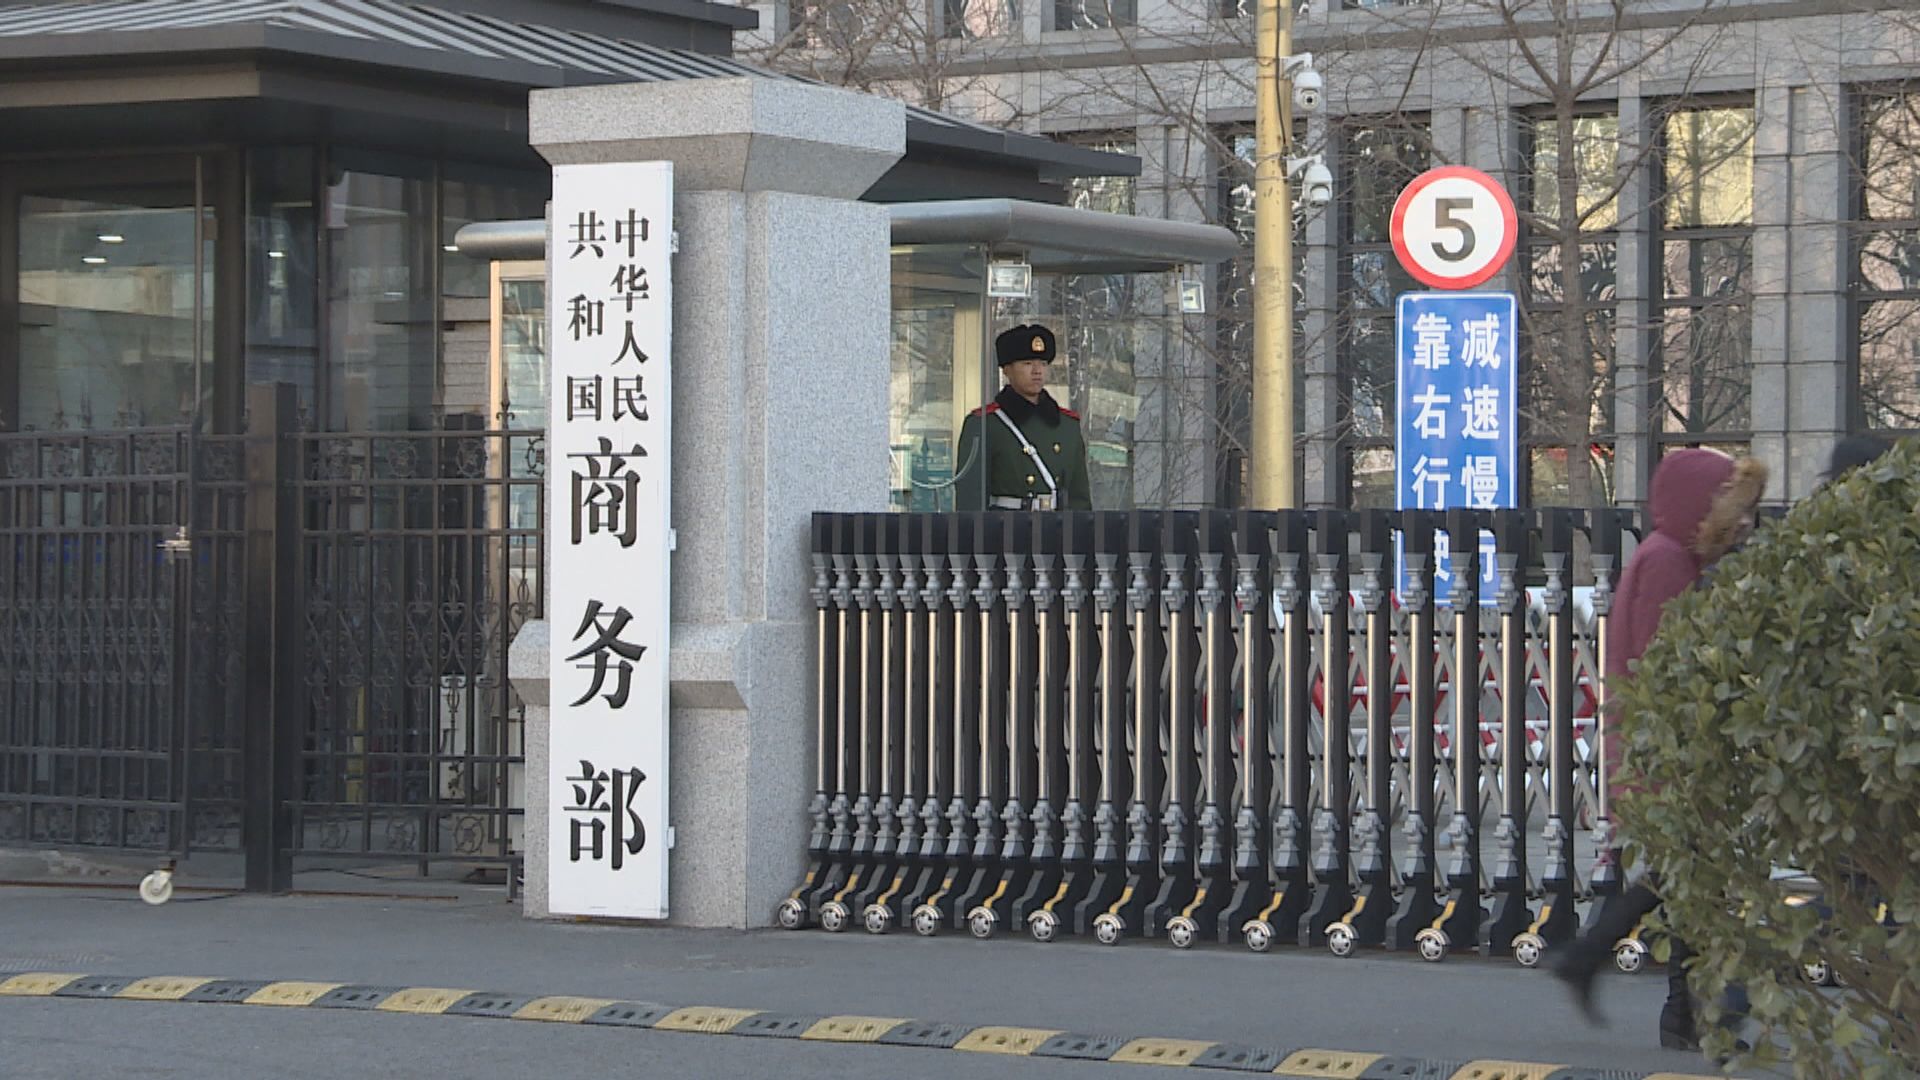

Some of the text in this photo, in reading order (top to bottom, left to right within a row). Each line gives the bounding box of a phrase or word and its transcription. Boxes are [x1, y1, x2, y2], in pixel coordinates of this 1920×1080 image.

[566, 210, 607, 422] 共和国
[611, 209, 649, 422] 中华人民
[1431, 198, 1476, 262] 5
[564, 437, 648, 871] 商务部
